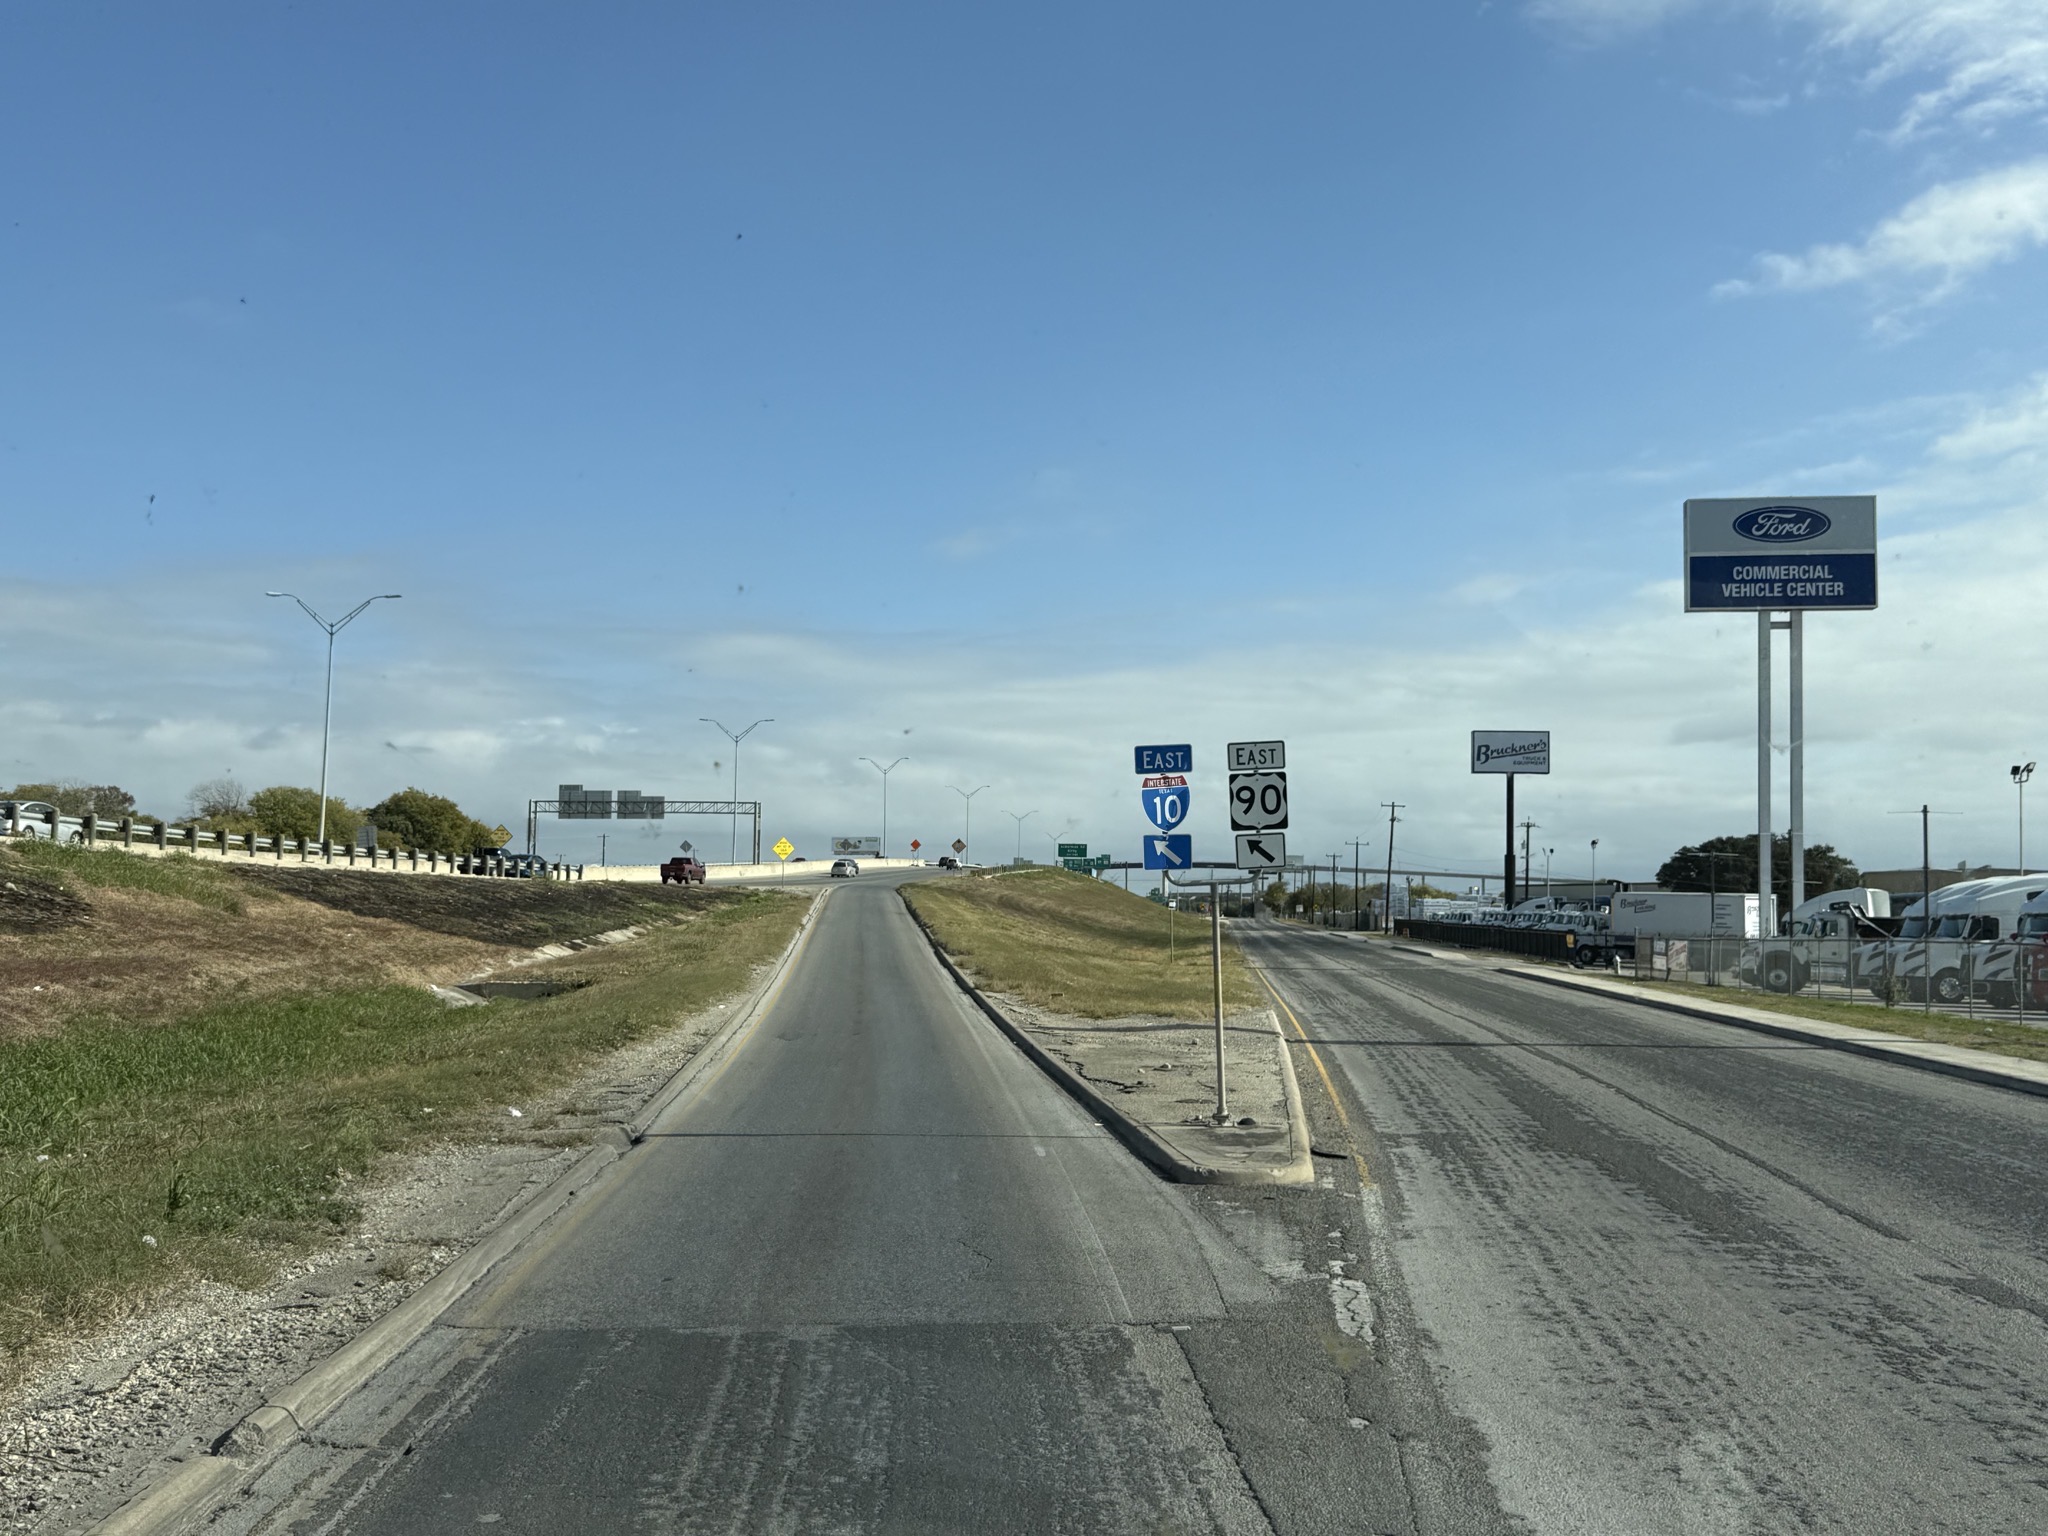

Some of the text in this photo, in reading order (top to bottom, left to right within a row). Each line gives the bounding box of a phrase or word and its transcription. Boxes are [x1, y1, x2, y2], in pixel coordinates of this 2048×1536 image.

[1752, 512, 1811, 536] Ford
[1733, 565, 1833, 580] COMMERCIAL
[1722, 581, 1844, 597] VEHICLE CENTER
[1143, 751, 1184, 769] EAST
[1236, 748, 1277, 766] EAST
[1476, 739, 1547, 765] Bruckner's
[1147, 778, 1182, 787] INTERSTATE
[1235, 784, 1282, 815] 90
[1153, 795, 1182, 824] 10
